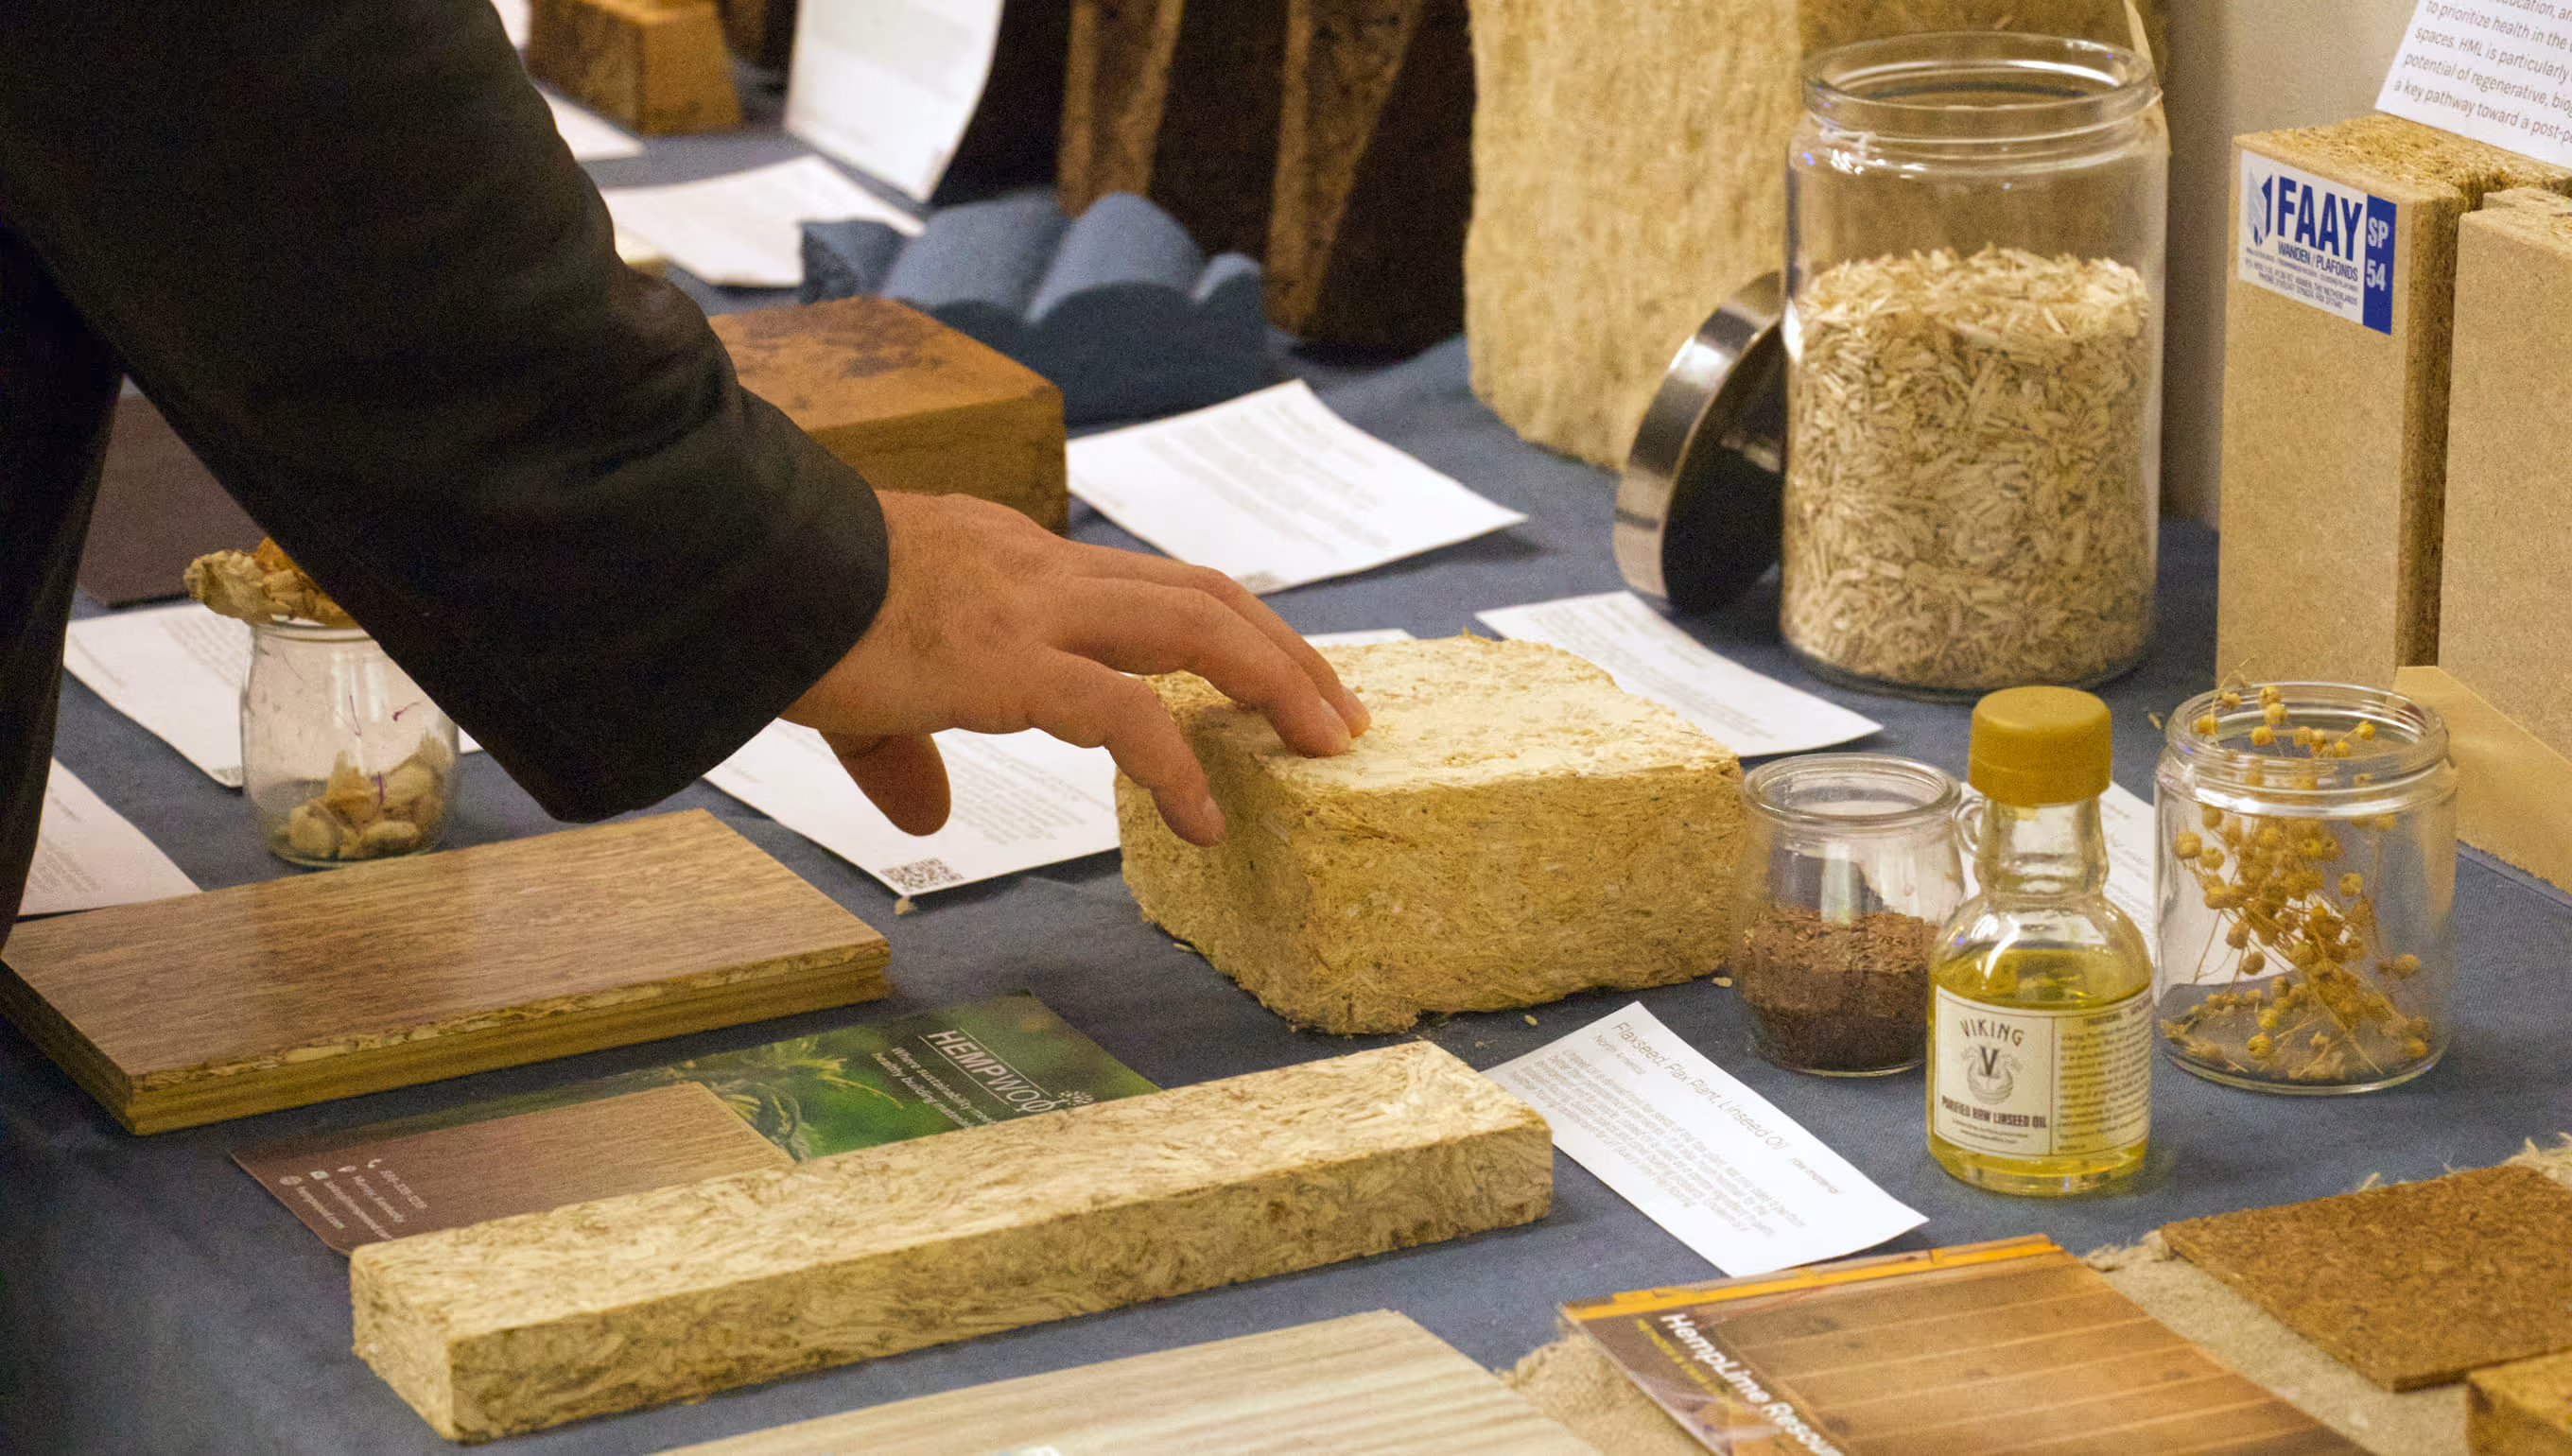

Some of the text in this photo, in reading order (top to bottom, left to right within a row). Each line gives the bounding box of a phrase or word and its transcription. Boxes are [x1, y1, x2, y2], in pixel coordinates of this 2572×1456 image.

[2426, 1, 2567, 50] to prioritize health in the
[2403, 53, 2458, 77] potential
[2457, 67, 2473, 81] of
[2471, 72, 2548, 106] regenerative,
[2459, 38, 2482, 57] HML
[2485, 43, 2497, 61] is
[2497, 51, 2570, 85] particularly
[2393, 80, 2403, 92] a
[2404, 78, 2424, 102] key
[2424, 89, 2476, 117] pathway
[2476, 103, 2520, 127] toward
[2520, 117, 2529, 130] a
[2277, 176, 2363, 262] FAAY
[2368, 217, 2390, 250] SP
[2277, 240, 2311, 266] WANDEN
[2317, 254, 2358, 282] PLAFONDS
[2366, 259, 2387, 291] 54
[1959, 1018, 2025, 1047] VIKING
[1980, 1046, 1999, 1076] V
[1718, 1101, 1772, 1137] Linseed
[1993, 1112, 2030, 1127] LINSEED
[2031, 1115, 2047, 1128] OIL
[1660, 1312, 1771, 1404] HempLime
